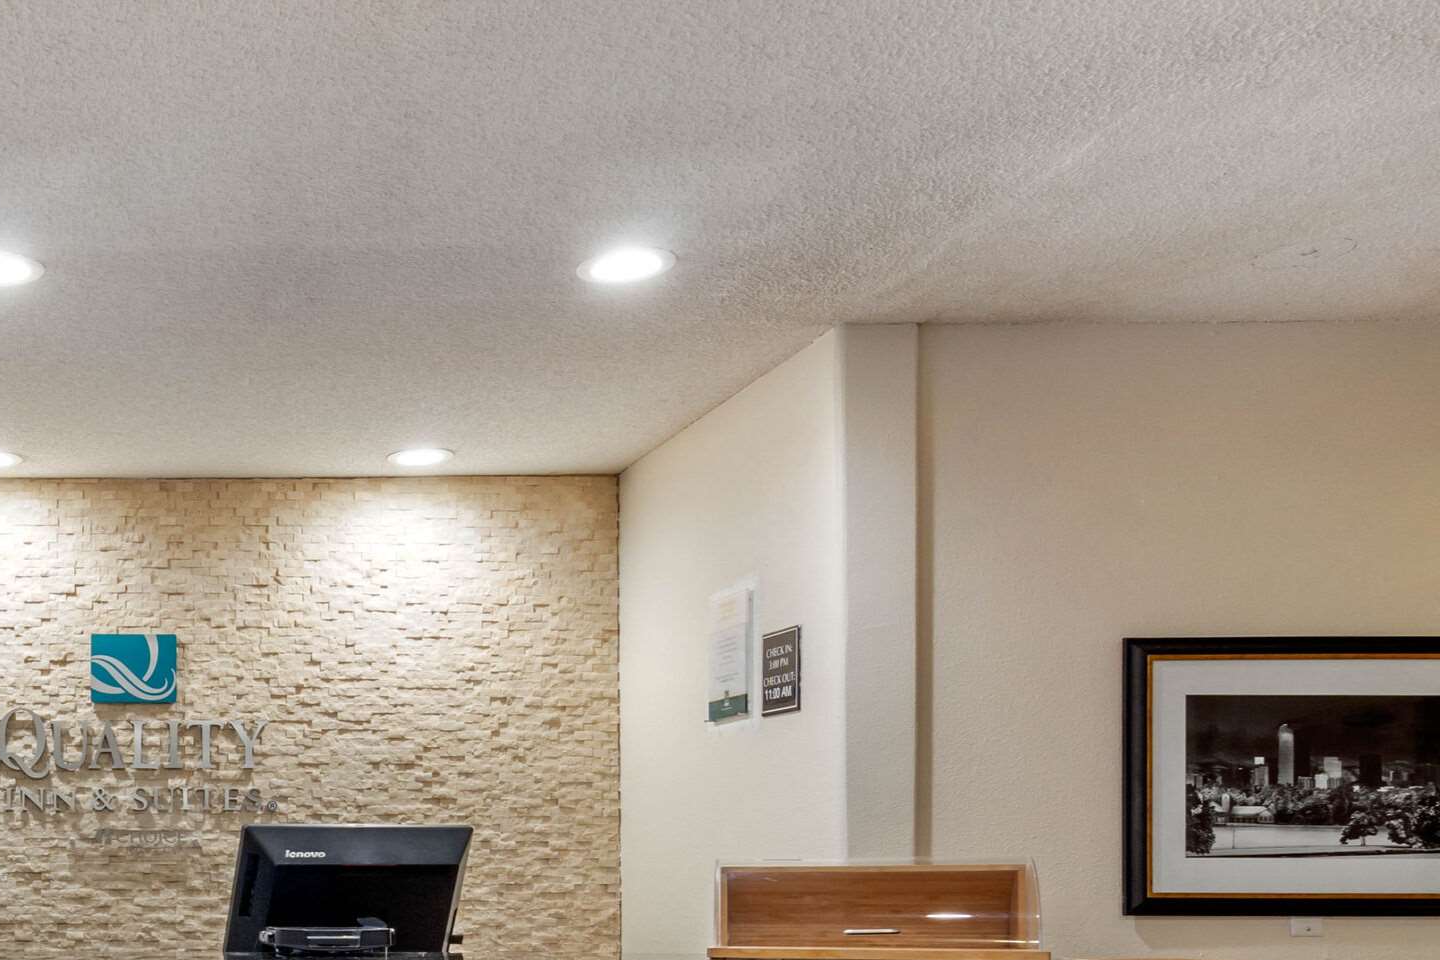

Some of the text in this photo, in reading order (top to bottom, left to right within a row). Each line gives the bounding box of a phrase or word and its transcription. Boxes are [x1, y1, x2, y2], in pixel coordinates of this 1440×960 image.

[766, 645, 784, 659] CHECK
[779, 657, 789, 668] PM
[763, 674, 781, 687] CHECK
[764, 685, 792, 700] 11:00 AM
[6, 786, 77, 812] INN
[91, 787, 114, 812] &
[285, 849, 326, 858] lenovo
